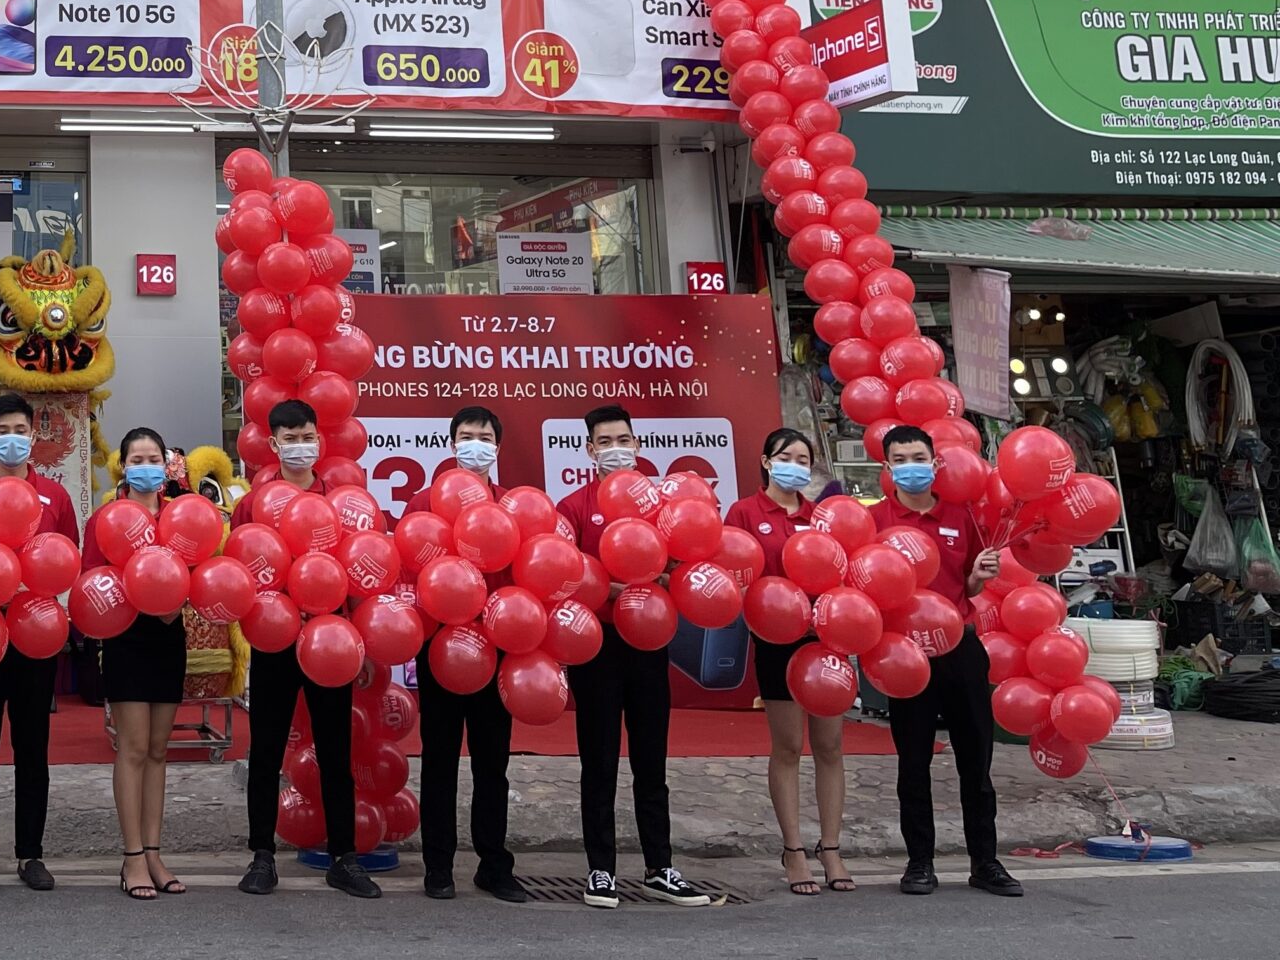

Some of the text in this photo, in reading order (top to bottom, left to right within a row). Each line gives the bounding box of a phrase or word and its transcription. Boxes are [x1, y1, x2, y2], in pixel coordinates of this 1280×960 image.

[58, 4, 175, 23] Note 10 5G
[1082, 9, 1125, 28] CÔNG
[1131, 12, 1149, 29] TY
[1156, 12, 1198, 29] TNHH
[1205, 11, 1243, 30] PHÁT
[373, 13, 470, 37] (MX 523)
[645, 26, 708, 46] Smart
[54, 45, 185, 72] 4.250.000
[376, 53, 480, 82] 650.000
[1117, 35, 1207, 82] GIA
[524, 58, 577, 88] 41%
[1121, 96, 1166, 110] Chuyên
[1170, 99, 1197, 110] cung
[1223, 98, 1242, 110] vật
[1103, 115, 1127, 126] Kim
[1130, 115, 1149, 126] khí
[1152, 114, 1179, 129] tổng
[1232, 115, 1255, 128] điện
[1091, 149, 1274, 166] Địa chỉ: Số 122 Lạc Long Quân,
[1116, 171, 1266, 186] Điện Thoại: 0975 182 094
[506, 256, 584, 266] Galaxy Note 20
[139, 265, 174, 283] 126
[526, 269, 565, 278] Ultra 5G
[689, 273, 724, 290] 126
[461, 315, 555, 333] Từ 2.7-8.7
[413, 340, 493, 369] BỪNG
[501, 346, 568, 368] KHAI
[575, 342, 694, 369] TRƯƠNG
[434, 383, 498, 397] 124-128
[504, 383, 536, 400] LẠC
[542, 383, 587, 397] LONG
[593, 379, 645, 399] QUÂN,
[651, 379, 674, 397] HÀ
[679, 379, 708, 400] NỘI
[415, 432, 450, 448] MÁY
[549, 436, 581, 451] PHỤ
[683, 432, 728, 447] HÃNG
